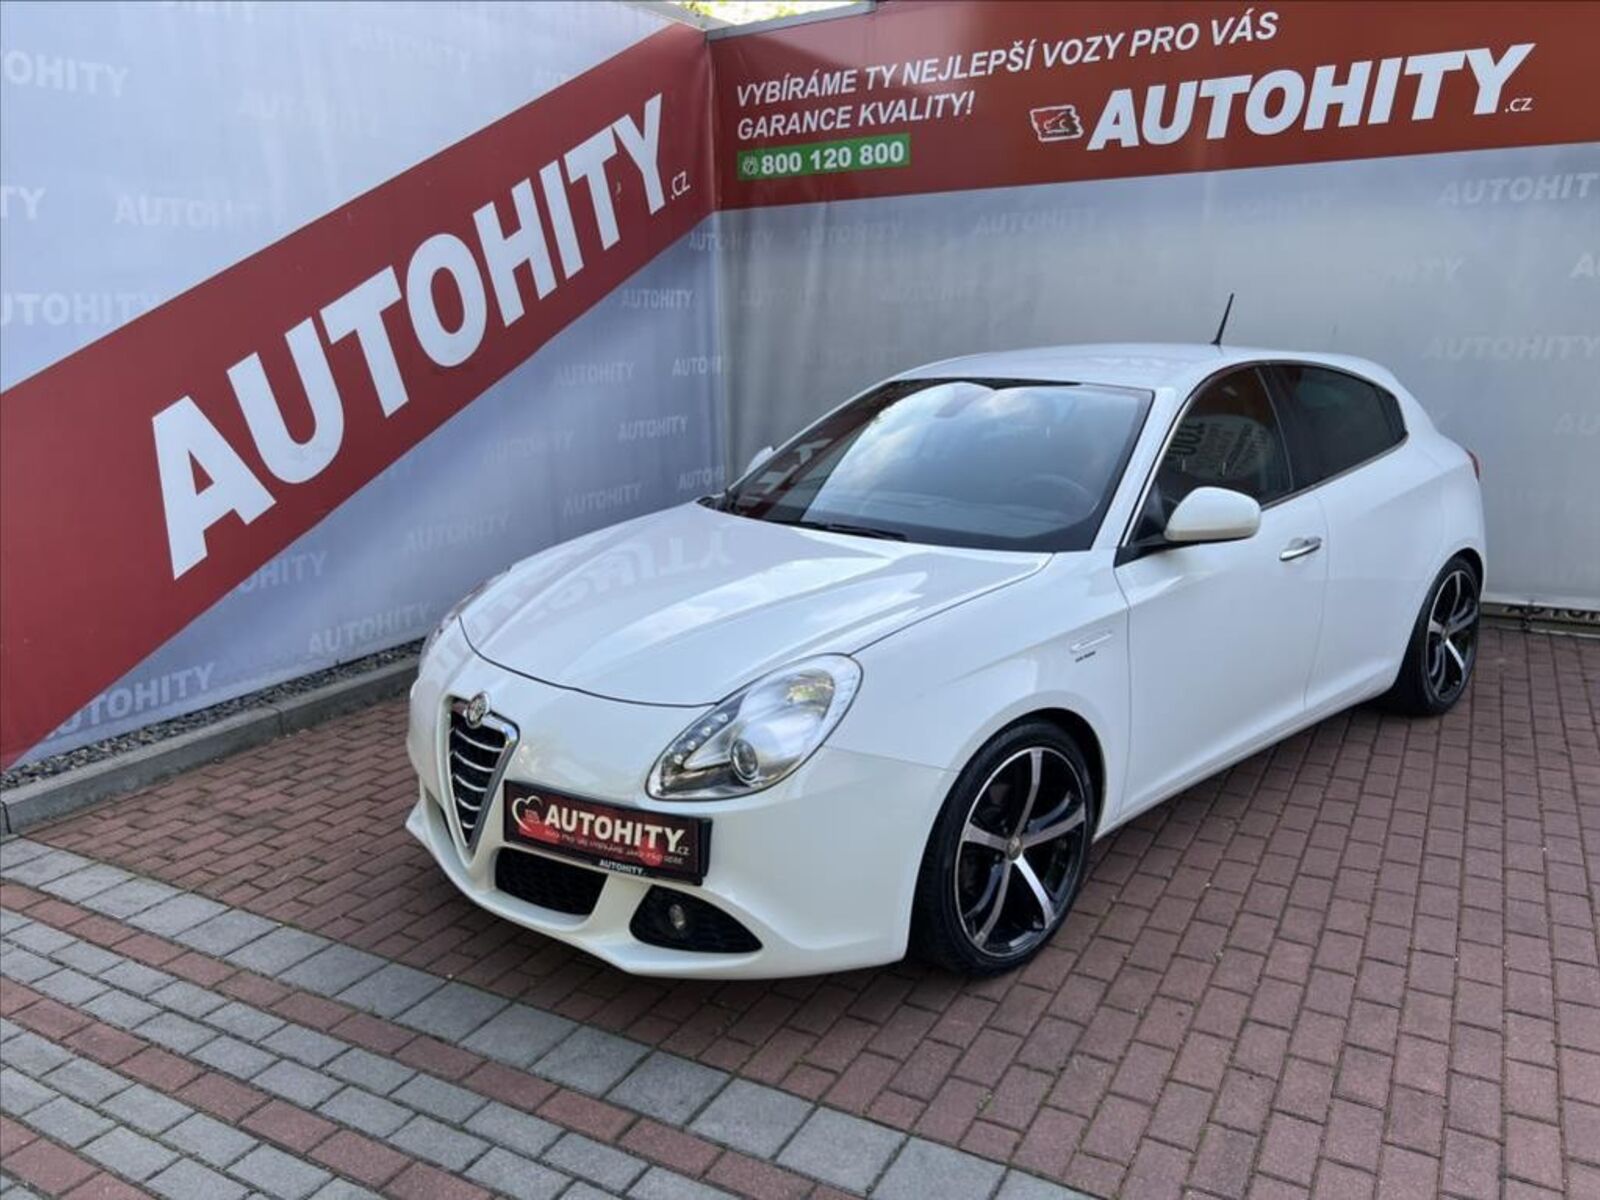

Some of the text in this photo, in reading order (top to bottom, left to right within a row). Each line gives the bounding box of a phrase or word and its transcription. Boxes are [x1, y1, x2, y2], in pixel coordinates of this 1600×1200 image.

[737, 8, 1279, 107] VYBÍRÁME TY NEJLEPŠÍ VOZY PRO VÁS
[737, 90, 976, 141] GARANCE KVALITY!
[1086, 42, 1536, 152] AUTOHITY
[761, 141, 905, 175] 800 120 800
[151, 92, 667, 581] AUTOHITY
[616, 413, 688, 443] AUTOHITY
[308, 599, 432, 657] AUTOHITY
[545, 804, 685, 854] AUTOHITY
[599, 859, 644, 876] AUTOHITY
